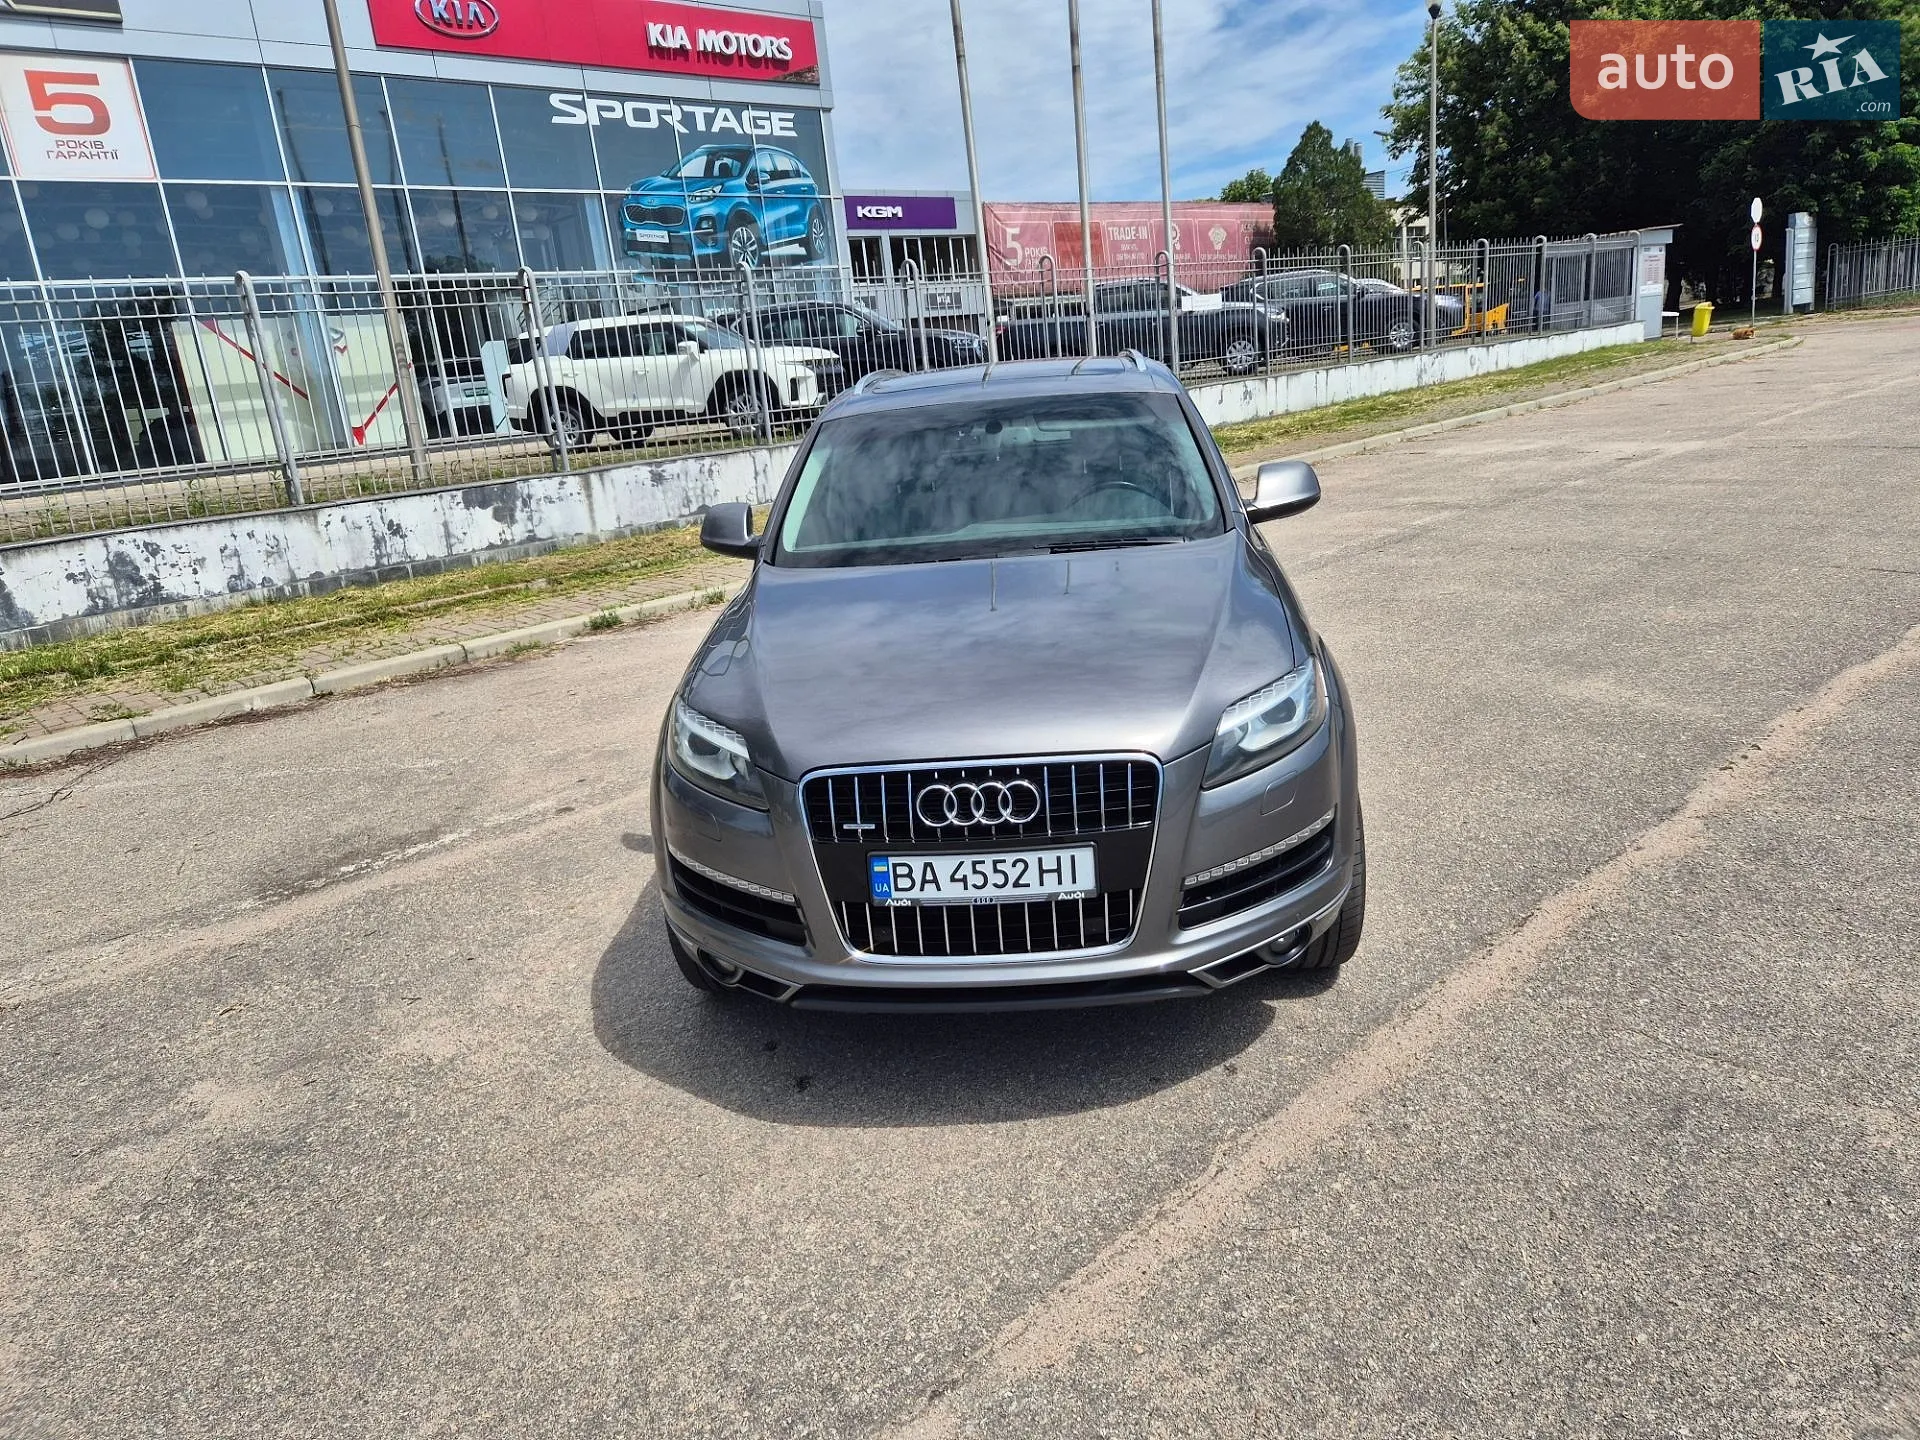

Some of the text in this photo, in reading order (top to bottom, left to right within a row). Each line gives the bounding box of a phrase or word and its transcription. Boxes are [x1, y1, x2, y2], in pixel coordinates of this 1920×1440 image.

[429, 0, 486, 26] KIA
[647, 22, 793, 61] KIA MOTORS
[24, 69, 111, 136] 5
[549, 93, 798, 137] SPORTAGE
[46, 149, 119, 161] ГАРАНТІЇ
[55, 139, 105, 150] РОКІВ
[856, 205, 903, 219] KGM
[1107, 225, 1148, 241] TRADE-IN
[1005, 226, 1023, 267] 5
[892, 854, 1077, 892] BA 4552 HI
[875, 883, 890, 893] UA
